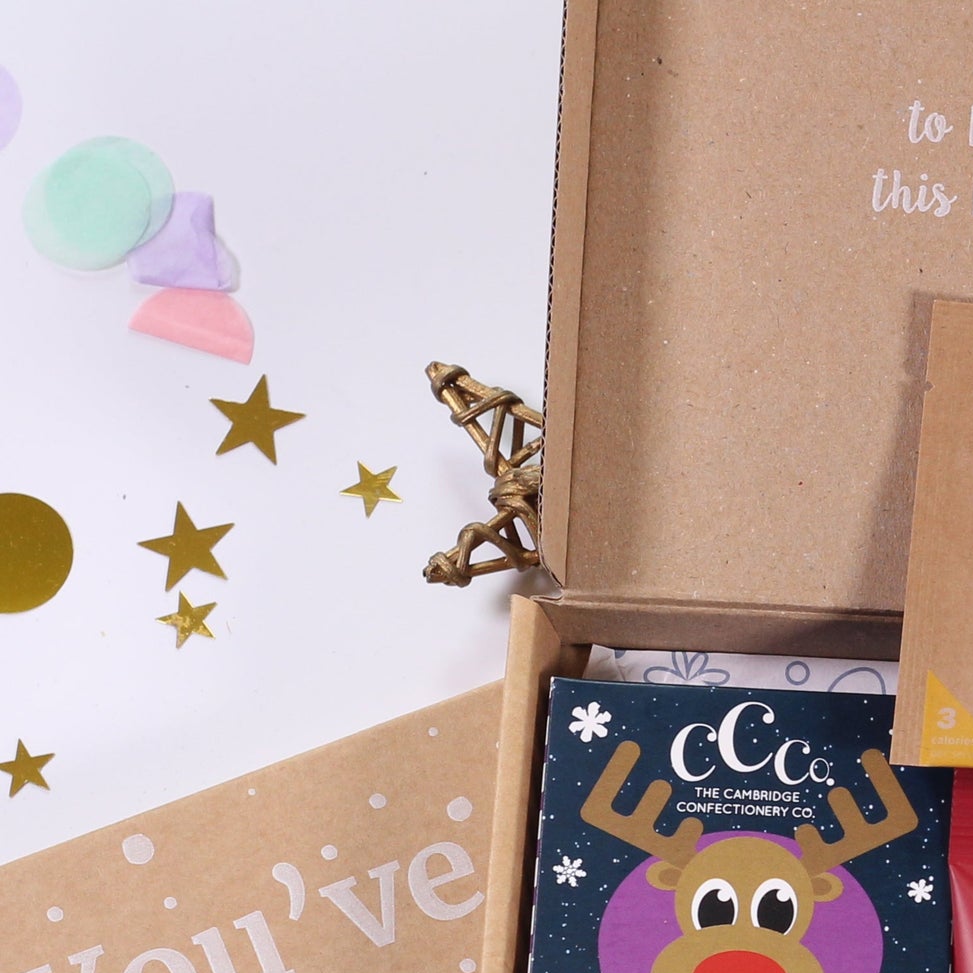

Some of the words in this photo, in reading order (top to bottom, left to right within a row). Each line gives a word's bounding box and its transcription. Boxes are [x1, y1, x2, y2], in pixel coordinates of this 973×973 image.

[908, 100, 952, 144] to
[871, 168, 958, 217] this
[937, 707, 956, 730] 3
[695, 787, 719, 799] THE
[723, 788, 800, 802] CAMBRIDGE
[676, 802, 788, 817] CONFECTIONERY
